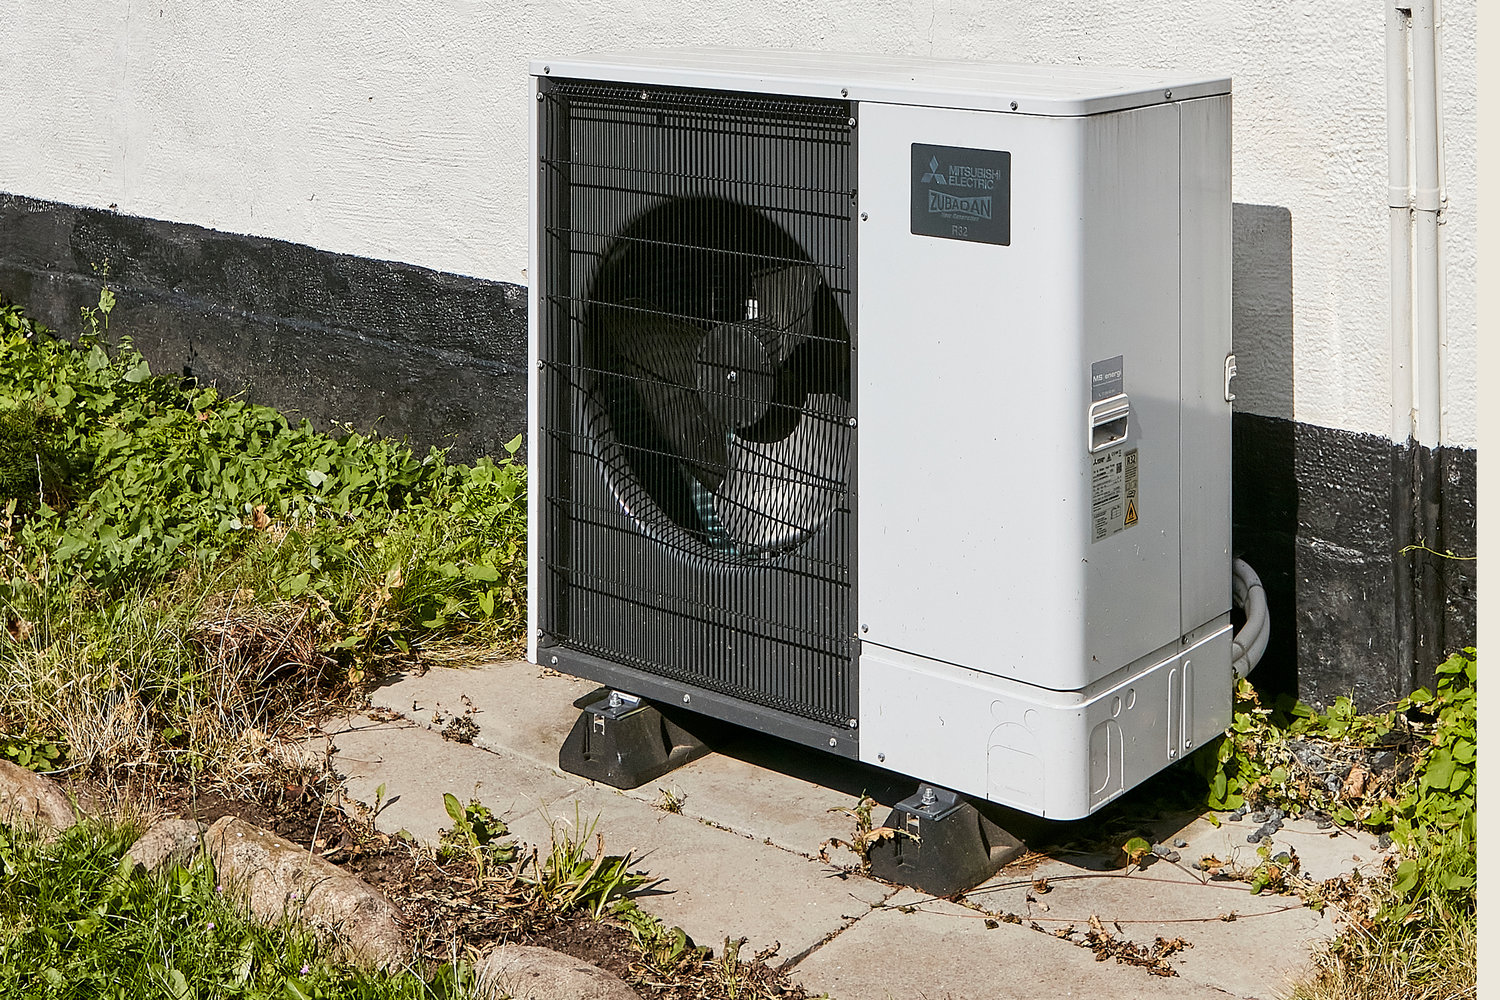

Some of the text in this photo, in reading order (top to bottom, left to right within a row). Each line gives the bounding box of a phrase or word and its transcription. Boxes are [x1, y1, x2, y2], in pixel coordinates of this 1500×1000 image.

[949, 165, 1000, 180] MITSUBISHI
[949, 177, 994, 190] ELECTRIC
[930, 193, 991, 218] ZUBADAN
[952, 225, 968, 237] R32
[1093, 373, 1103, 382] MS
